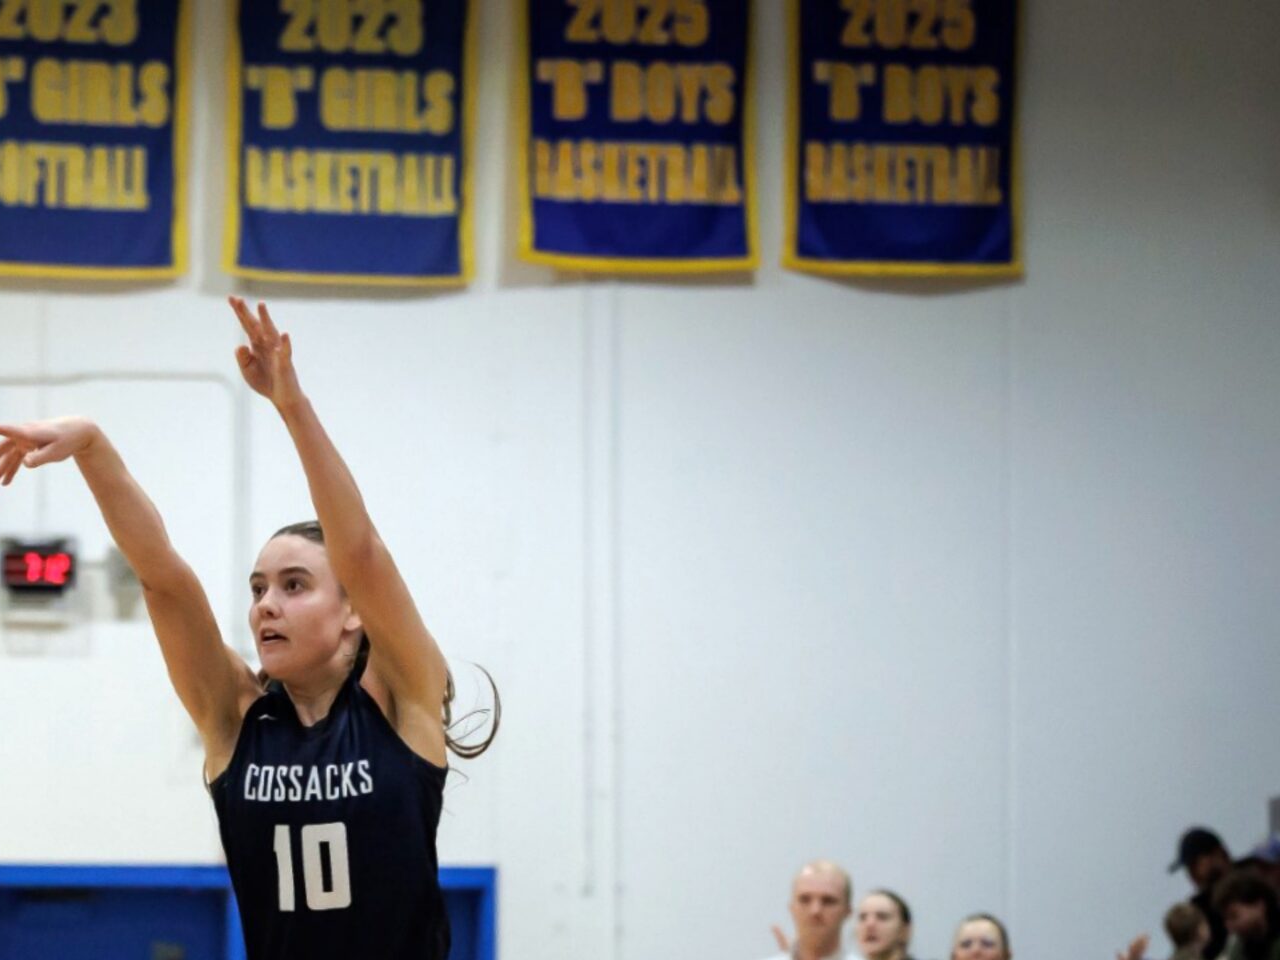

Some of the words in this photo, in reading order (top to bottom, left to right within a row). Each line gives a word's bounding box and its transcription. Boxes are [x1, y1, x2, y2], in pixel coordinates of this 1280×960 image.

[31, 57, 169, 128] GIRLS
[322, 66, 456, 135] GIRLS
[610, 60, 735, 126] BOYS
[882, 63, 1000, 126] BOYS
[245, 146, 457, 217] BASKETBALL
[533, 139, 742, 206] BASKETBALL
[805, 139, 1002, 206] BASKETBALL
[244, 759, 373, 802] COSSACKS
[273, 821, 352, 912] 10
